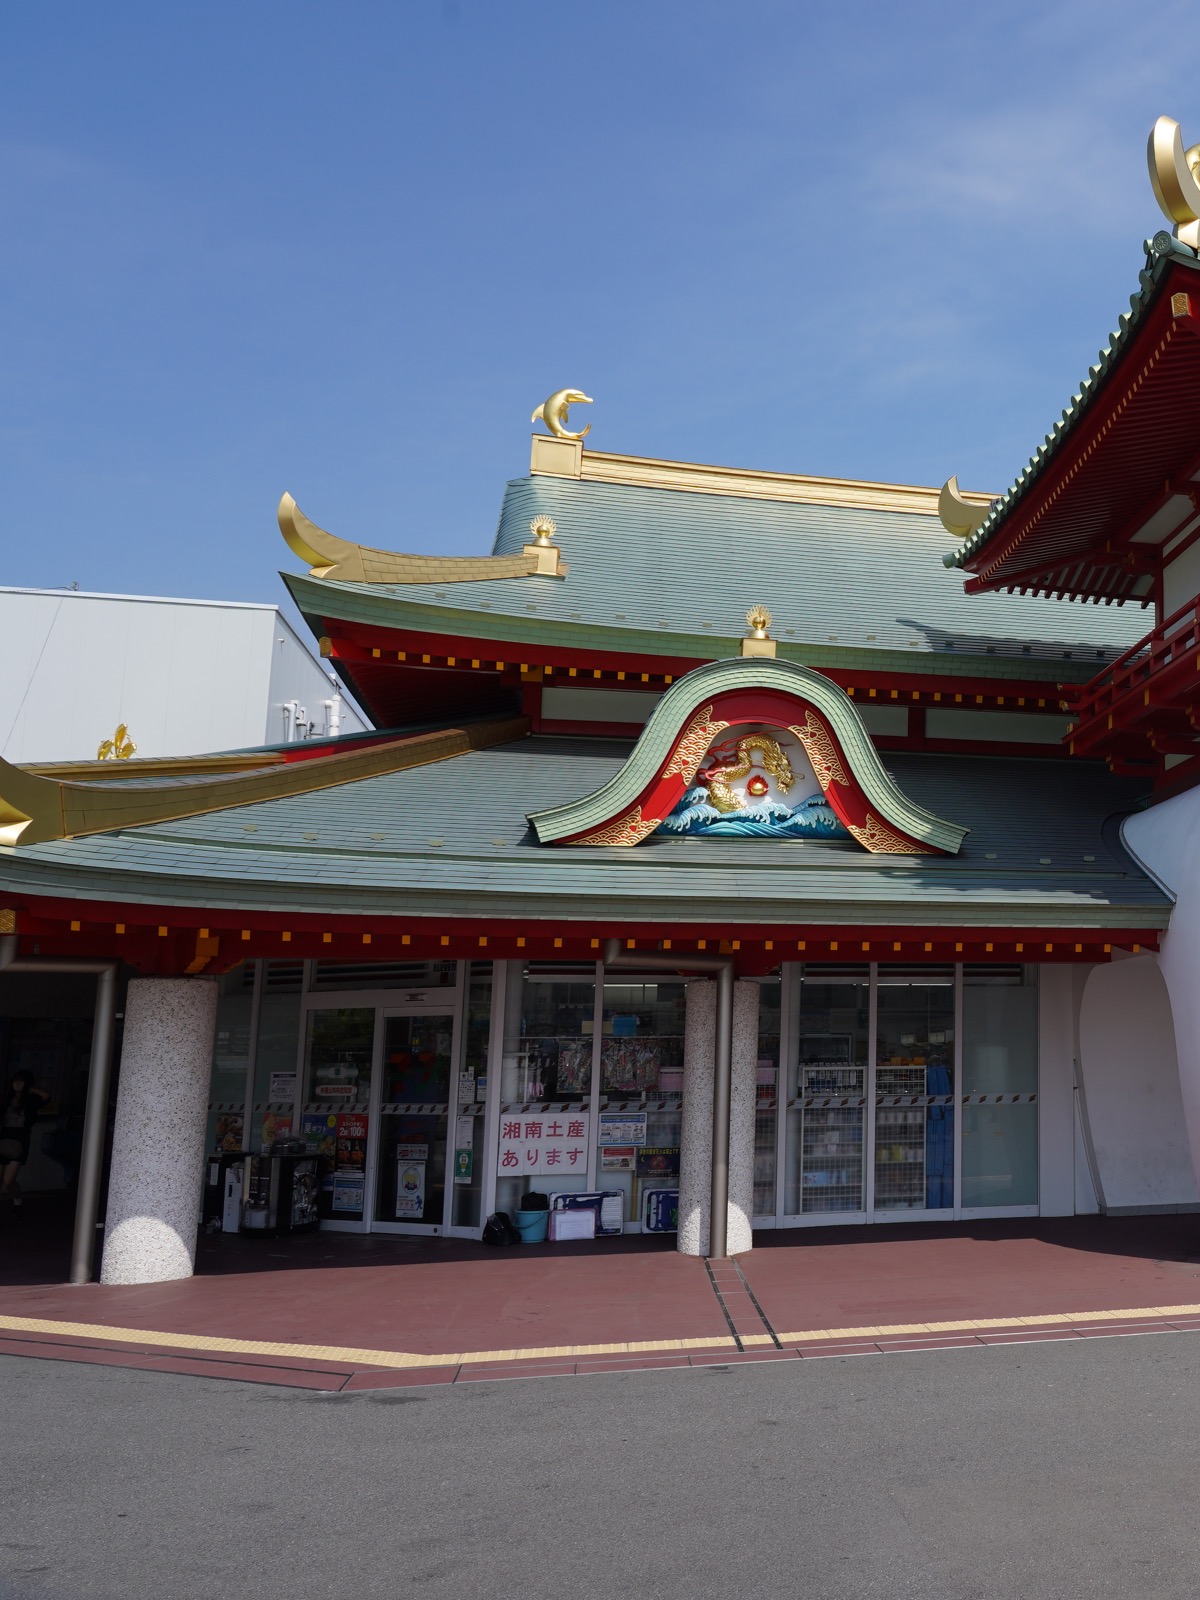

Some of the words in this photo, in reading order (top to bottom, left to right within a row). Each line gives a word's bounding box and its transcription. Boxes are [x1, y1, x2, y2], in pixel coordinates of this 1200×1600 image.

[502, 1120, 585, 1139] 湘南土産
[501, 1148, 584, 1167] あります
